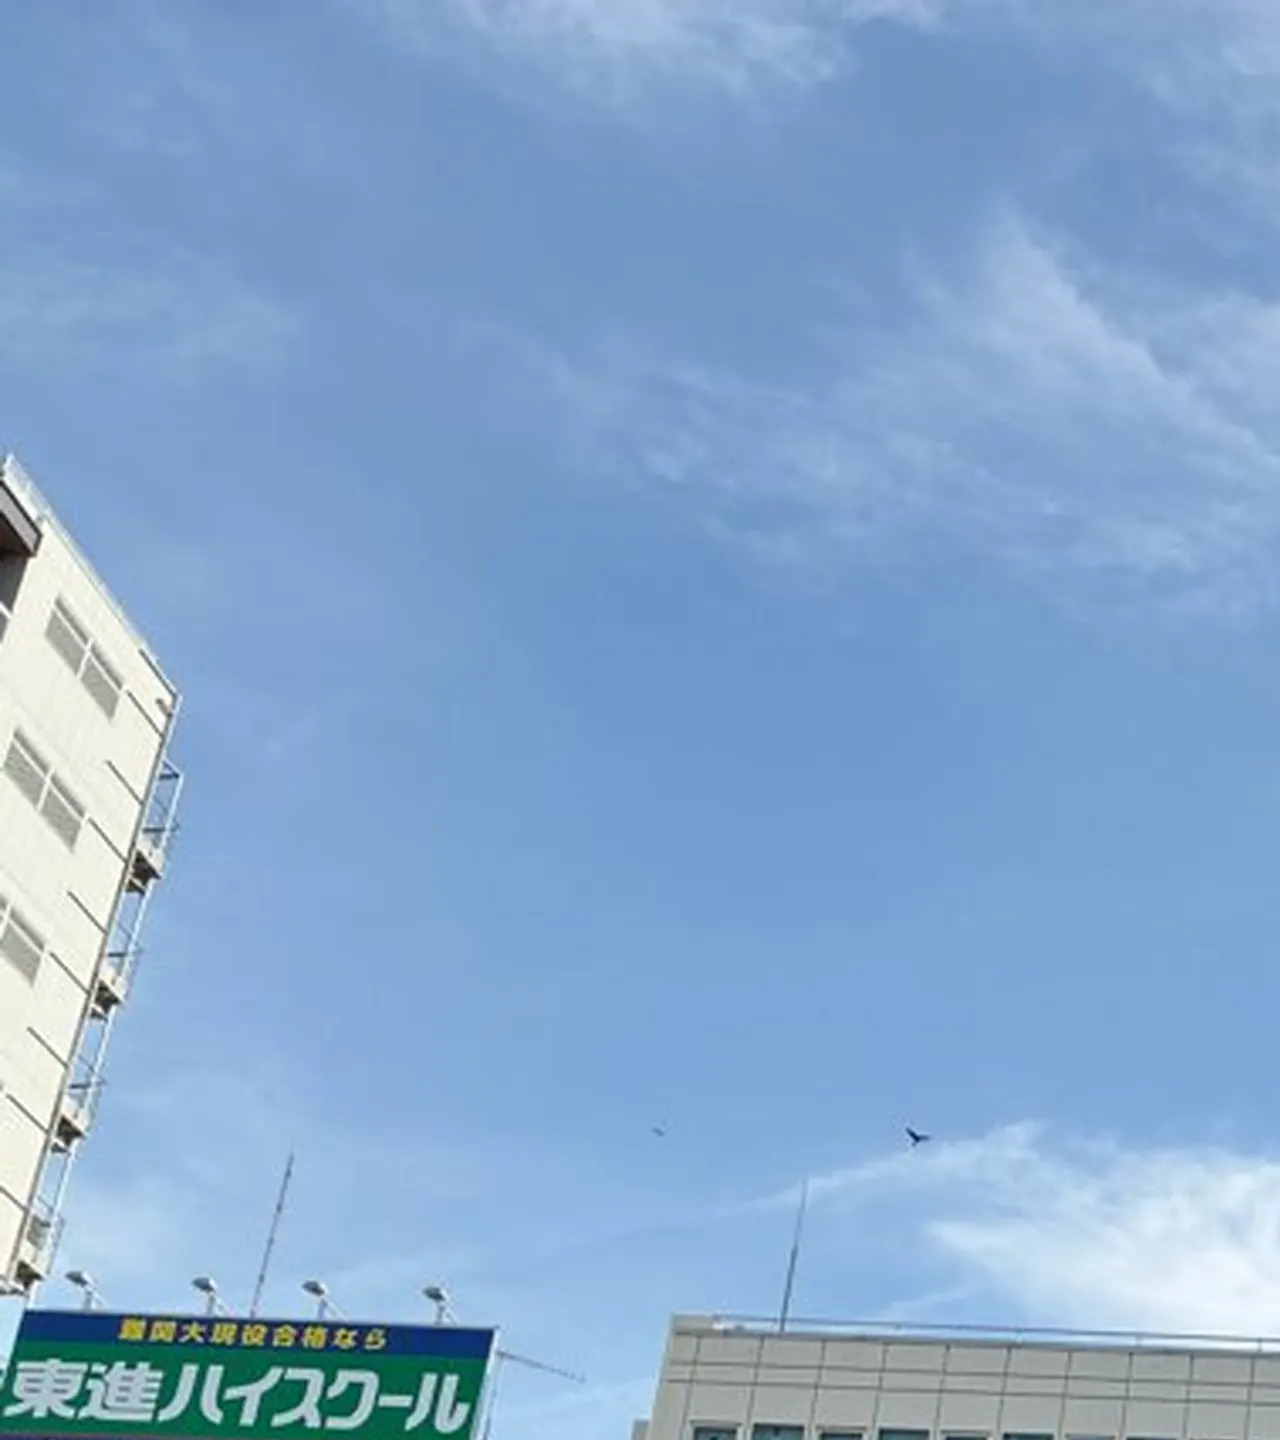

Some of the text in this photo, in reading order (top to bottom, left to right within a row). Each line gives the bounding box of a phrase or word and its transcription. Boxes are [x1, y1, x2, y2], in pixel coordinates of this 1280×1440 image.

[118, 1317, 388, 1350] 難関大現役合格なら
[4, 1358, 474, 1434] 東進ハイスクール
